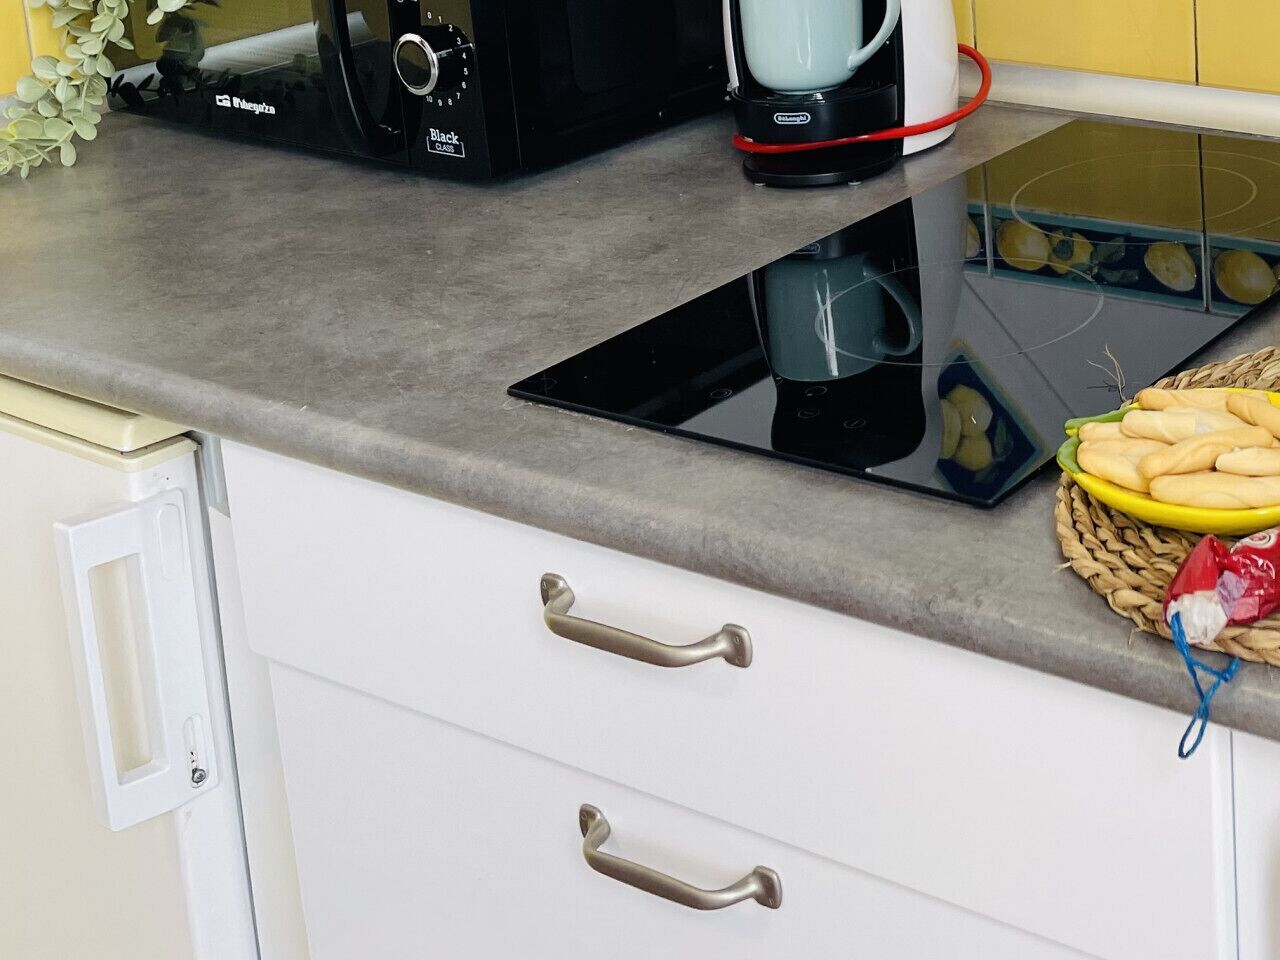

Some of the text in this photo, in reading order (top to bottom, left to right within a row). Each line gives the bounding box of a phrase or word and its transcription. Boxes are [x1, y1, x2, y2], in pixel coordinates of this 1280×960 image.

[425, 11, 469, 107] 0 1 2 3 4 5 6 7 8 9 10
[429, 128, 460, 145] Black
[435, 142, 455, 153] CLASS
